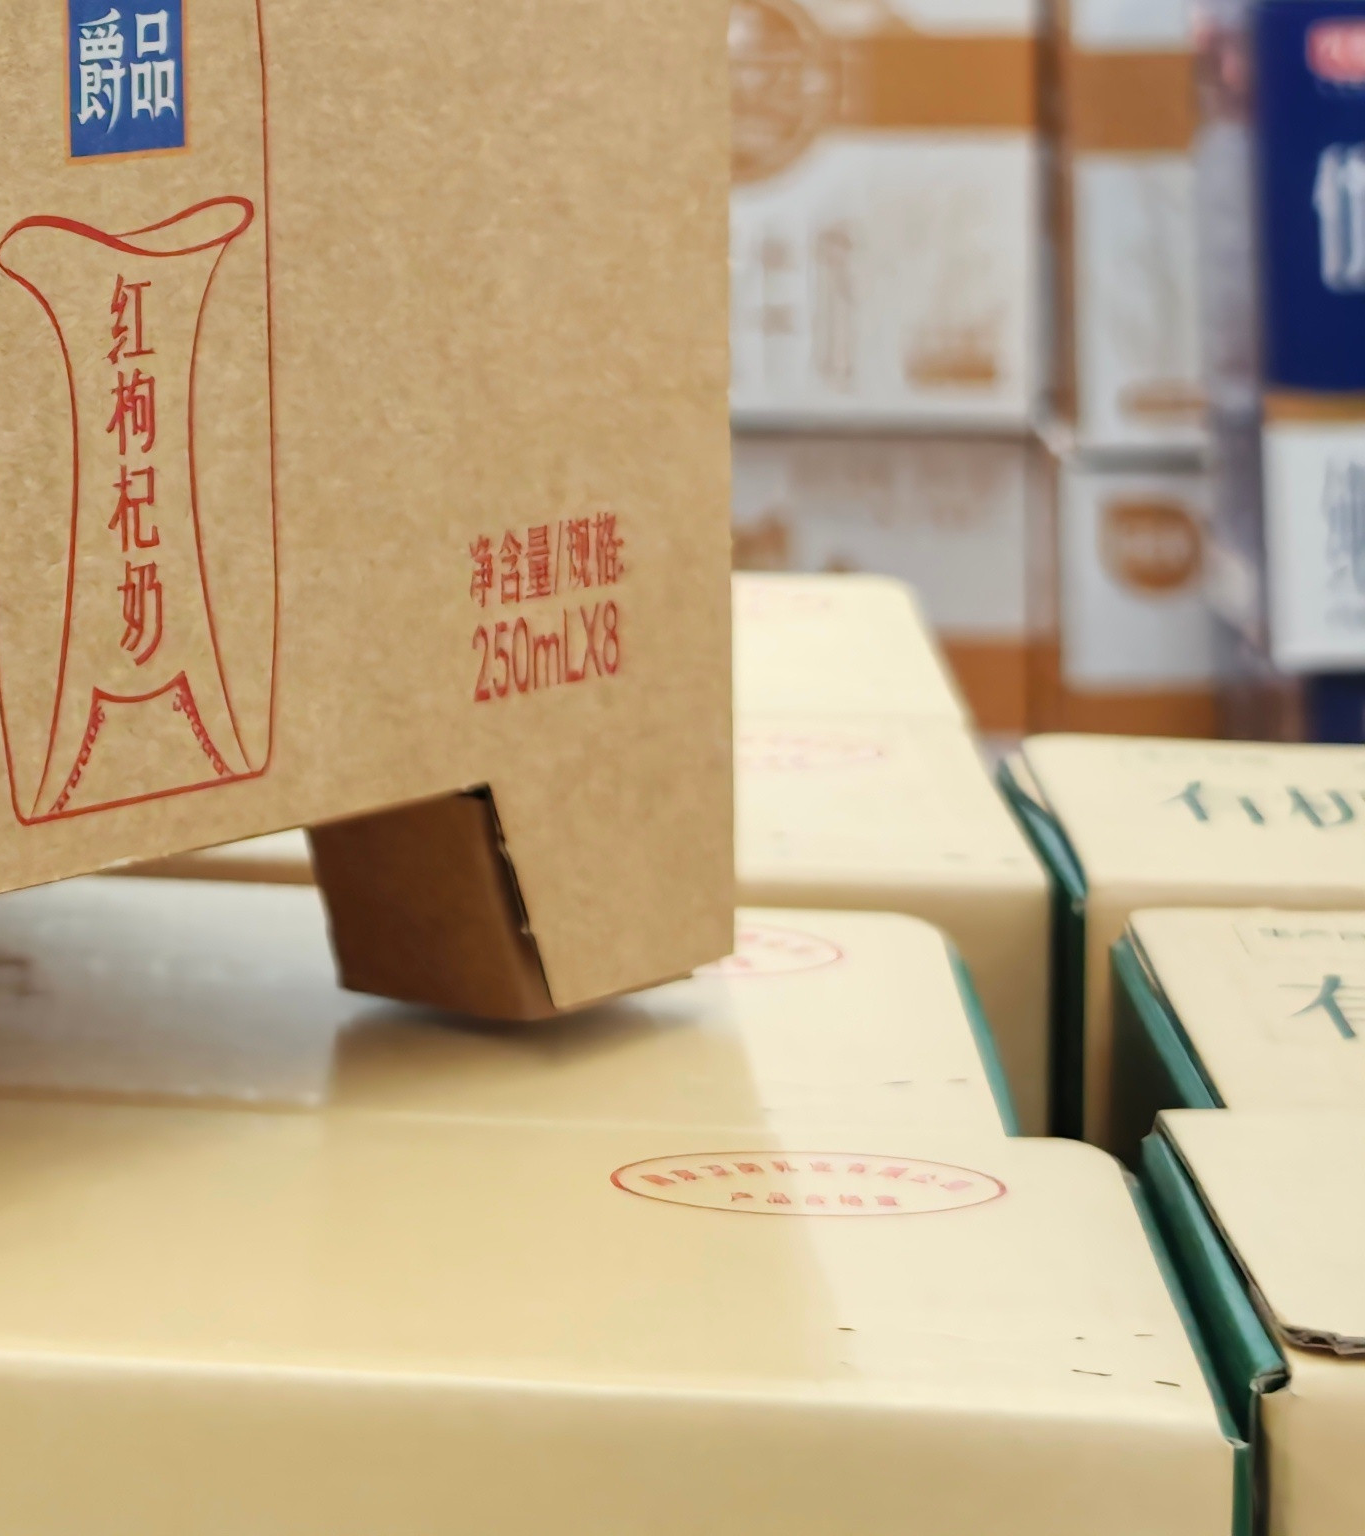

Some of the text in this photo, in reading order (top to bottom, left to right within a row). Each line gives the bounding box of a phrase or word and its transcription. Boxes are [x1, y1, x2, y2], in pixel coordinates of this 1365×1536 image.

[76, 6, 179, 135] 爵品
[105, 273, 169, 667] 红枸杞奶
